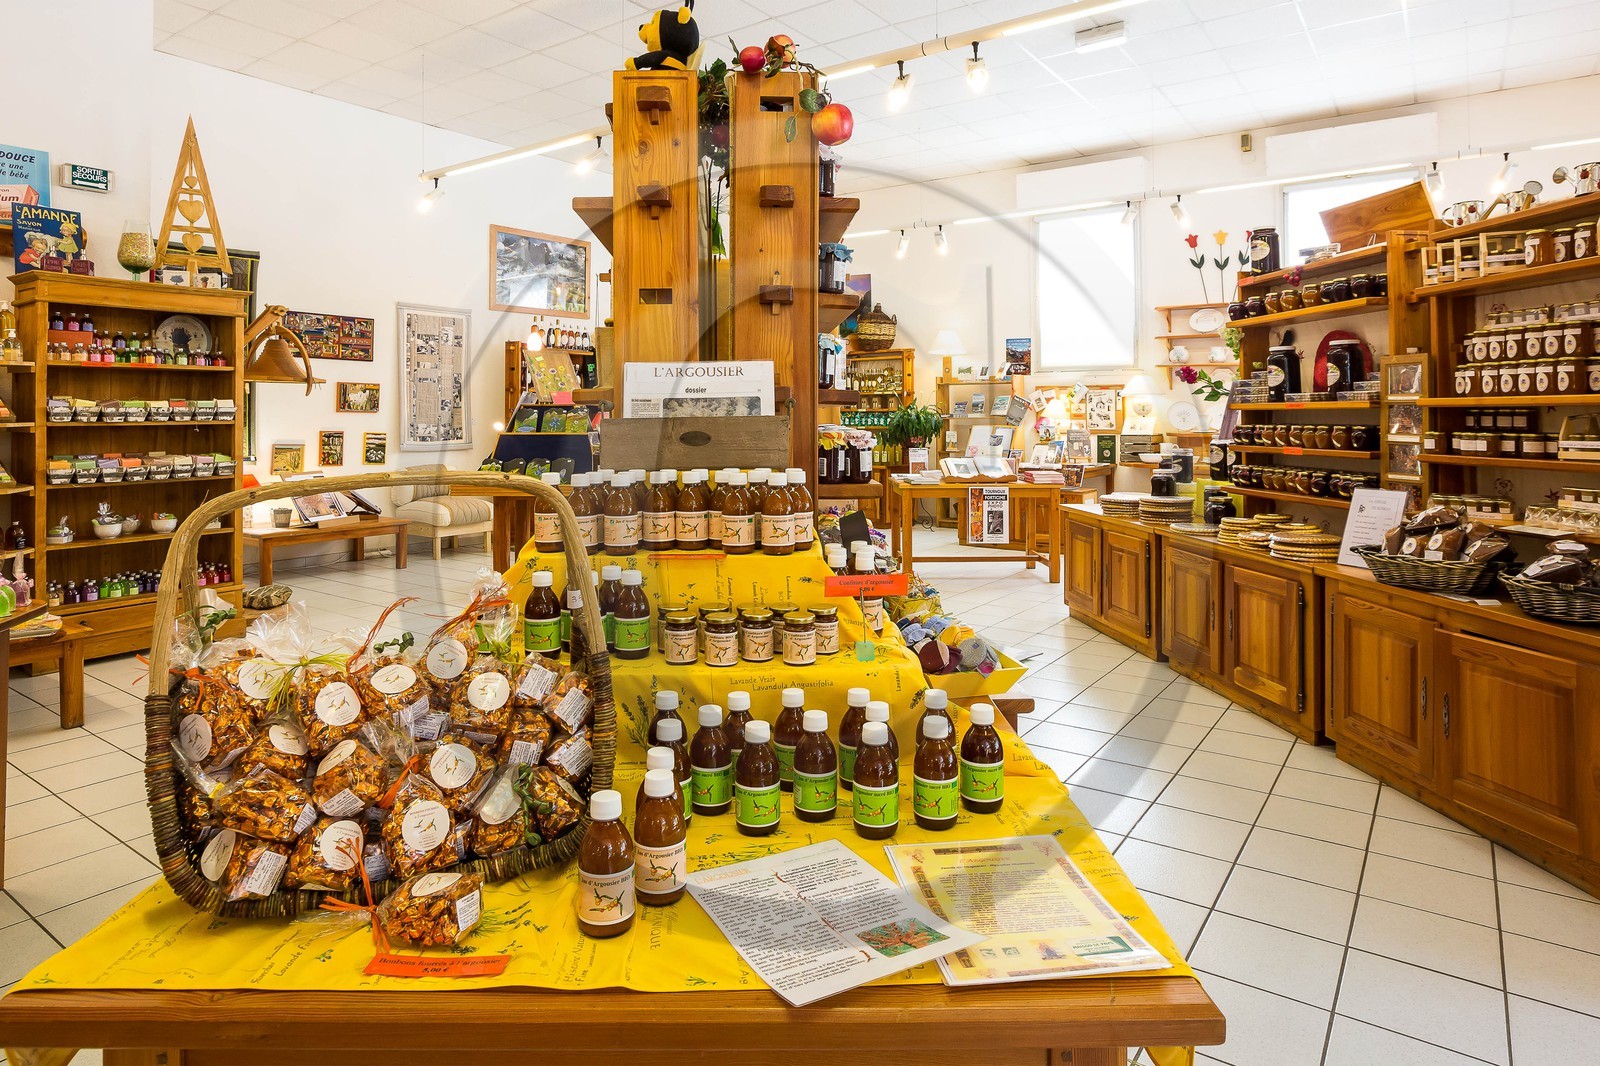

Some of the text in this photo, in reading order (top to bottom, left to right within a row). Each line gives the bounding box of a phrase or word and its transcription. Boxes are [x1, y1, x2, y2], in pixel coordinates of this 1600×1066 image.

[0, 150, 35, 164] DOUCE
[10, 171, 29, 180] bébé
[76, 166, 103, 176] SORTIE
[72, 172, 107, 183] SECOURS
[16, 205, 77, 224] L'AMANDE
[654, 366, 744, 378] L'ARGOUSIER
[752, 680, 834, 691] Lavandula Angustifolia
[644, 850, 674, 859] d'Argousier
[588, 879, 619, 887] d'Argousier
[620, 875, 630, 883] BIO
[273, 952, 302, 976] Lavande
[379, 958, 416, 966] Bonbons
